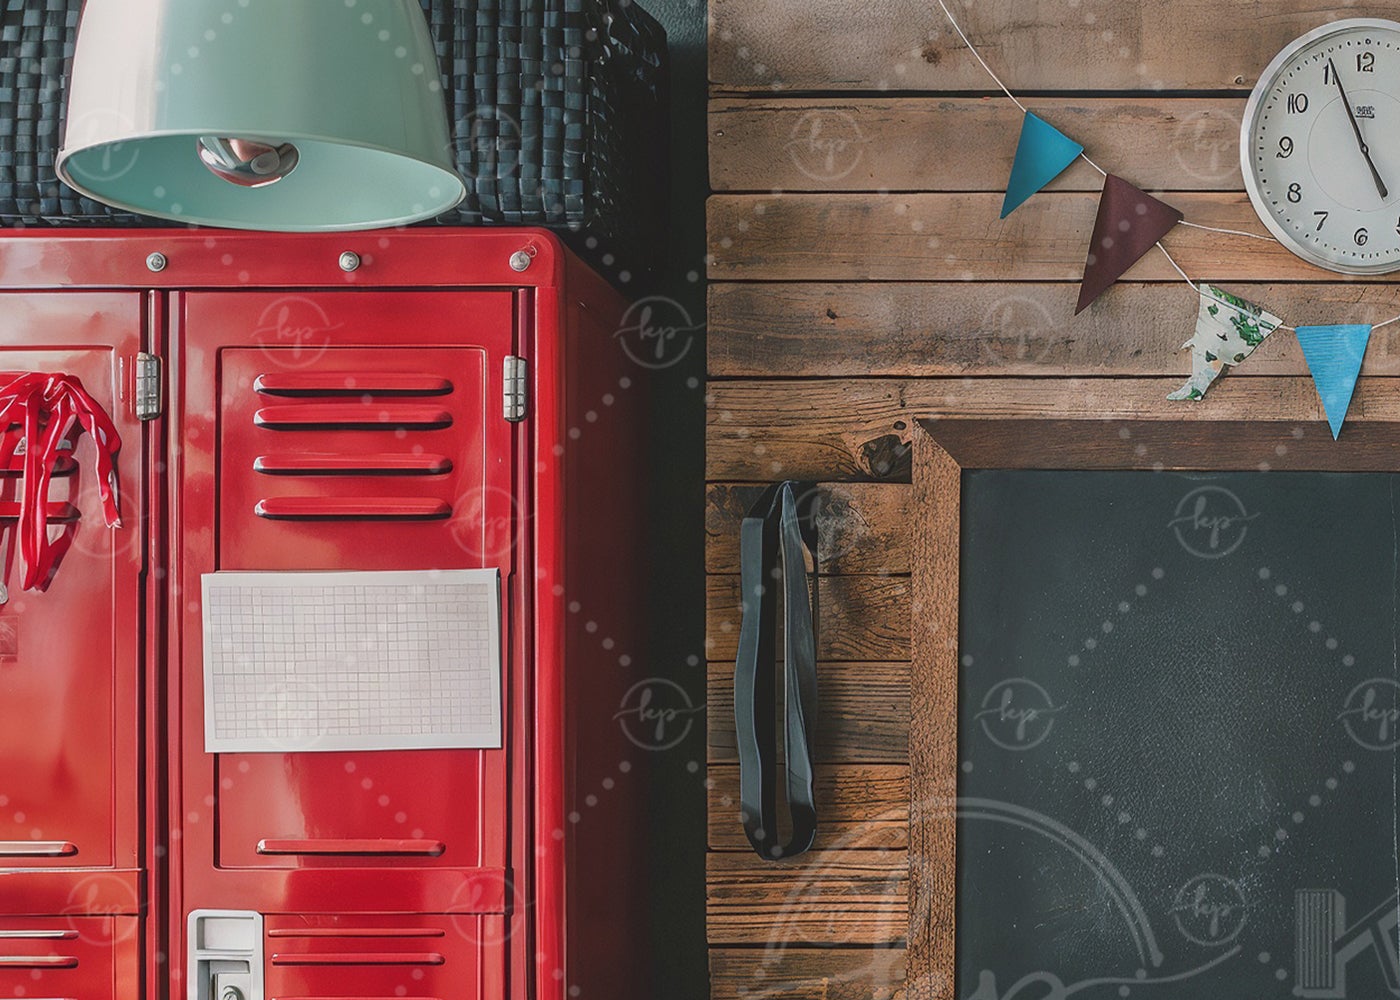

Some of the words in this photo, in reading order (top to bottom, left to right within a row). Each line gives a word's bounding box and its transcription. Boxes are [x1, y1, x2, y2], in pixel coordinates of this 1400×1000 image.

[1356, 51, 1376, 73] 12
[1275, 135, 1295, 159] 9
[1286, 182, 1302, 204] 8
[1313, 210, 1329, 231] 7
[1353, 227, 1369, 247] 6
